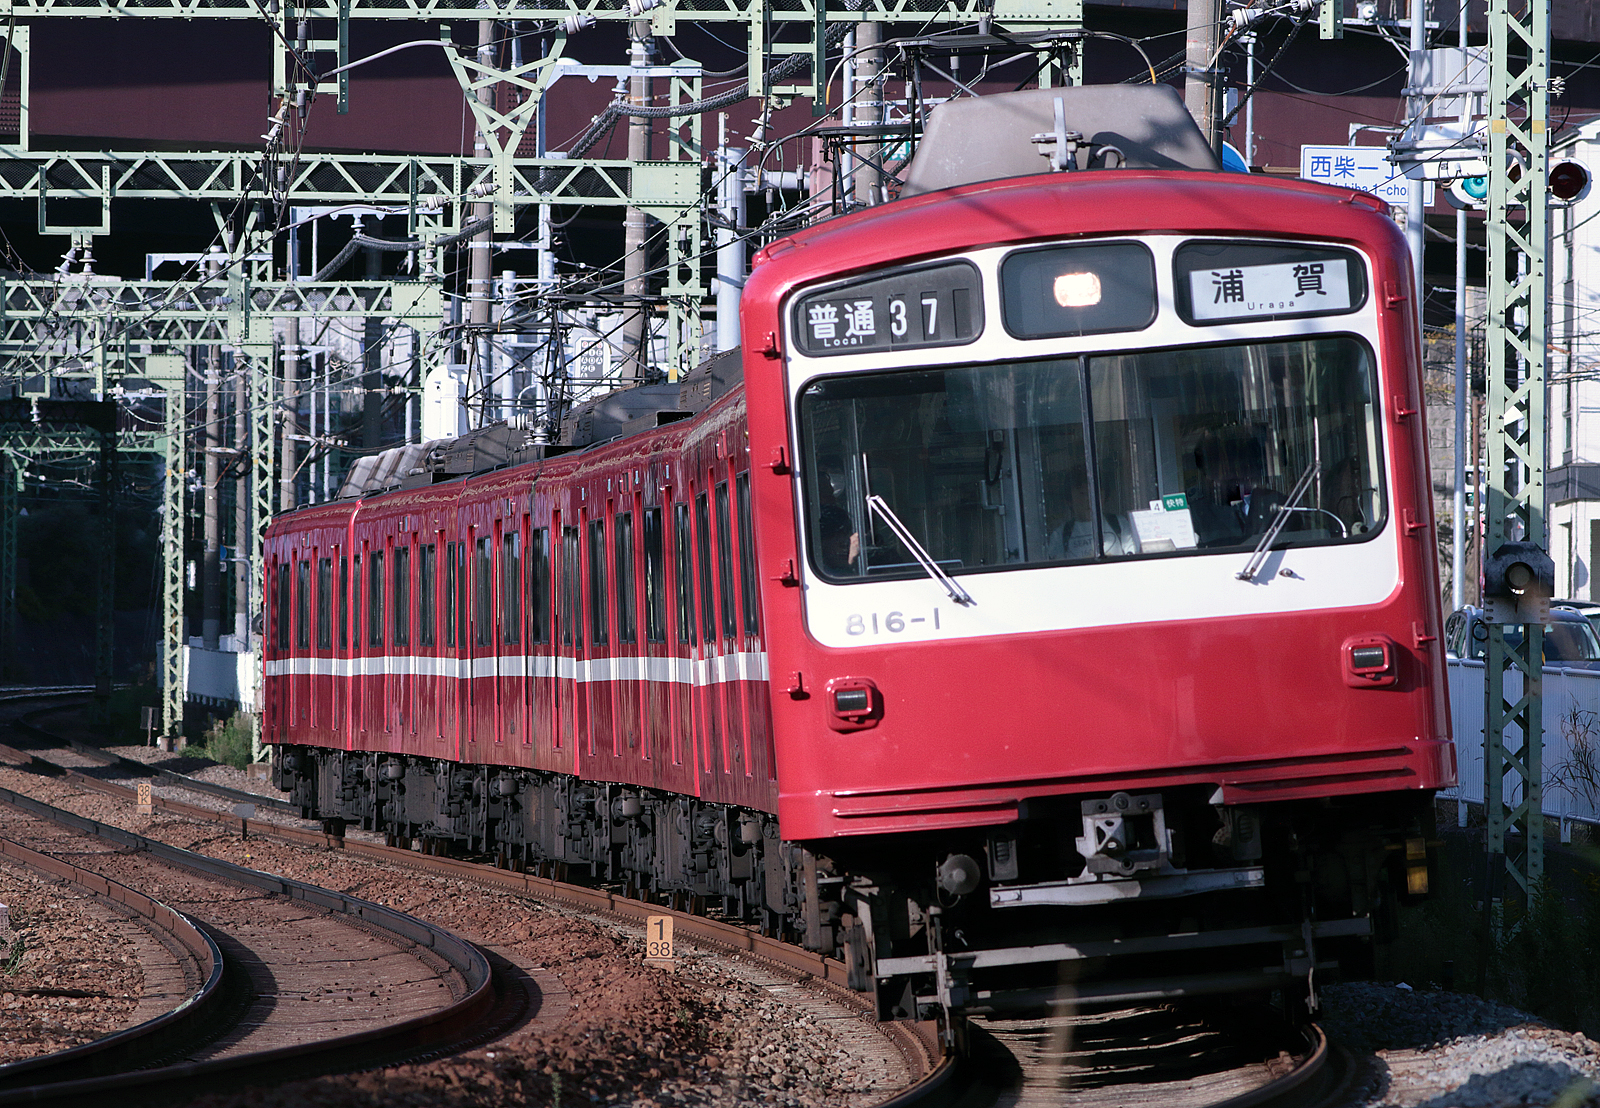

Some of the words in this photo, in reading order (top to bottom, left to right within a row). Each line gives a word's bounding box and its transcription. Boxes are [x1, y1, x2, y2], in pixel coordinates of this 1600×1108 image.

[1211, 263, 1327, 304] 浦賀
[1247, 300, 1295, 311] Uraga
[809, 300, 876, 339] 普通
[824, 336, 864, 347] Local
[845, 607, 940, 636] 816-1
[138, 785, 150, 796] 38
[653, 918, 664, 941] 1
[649, 941, 671, 957] 38
